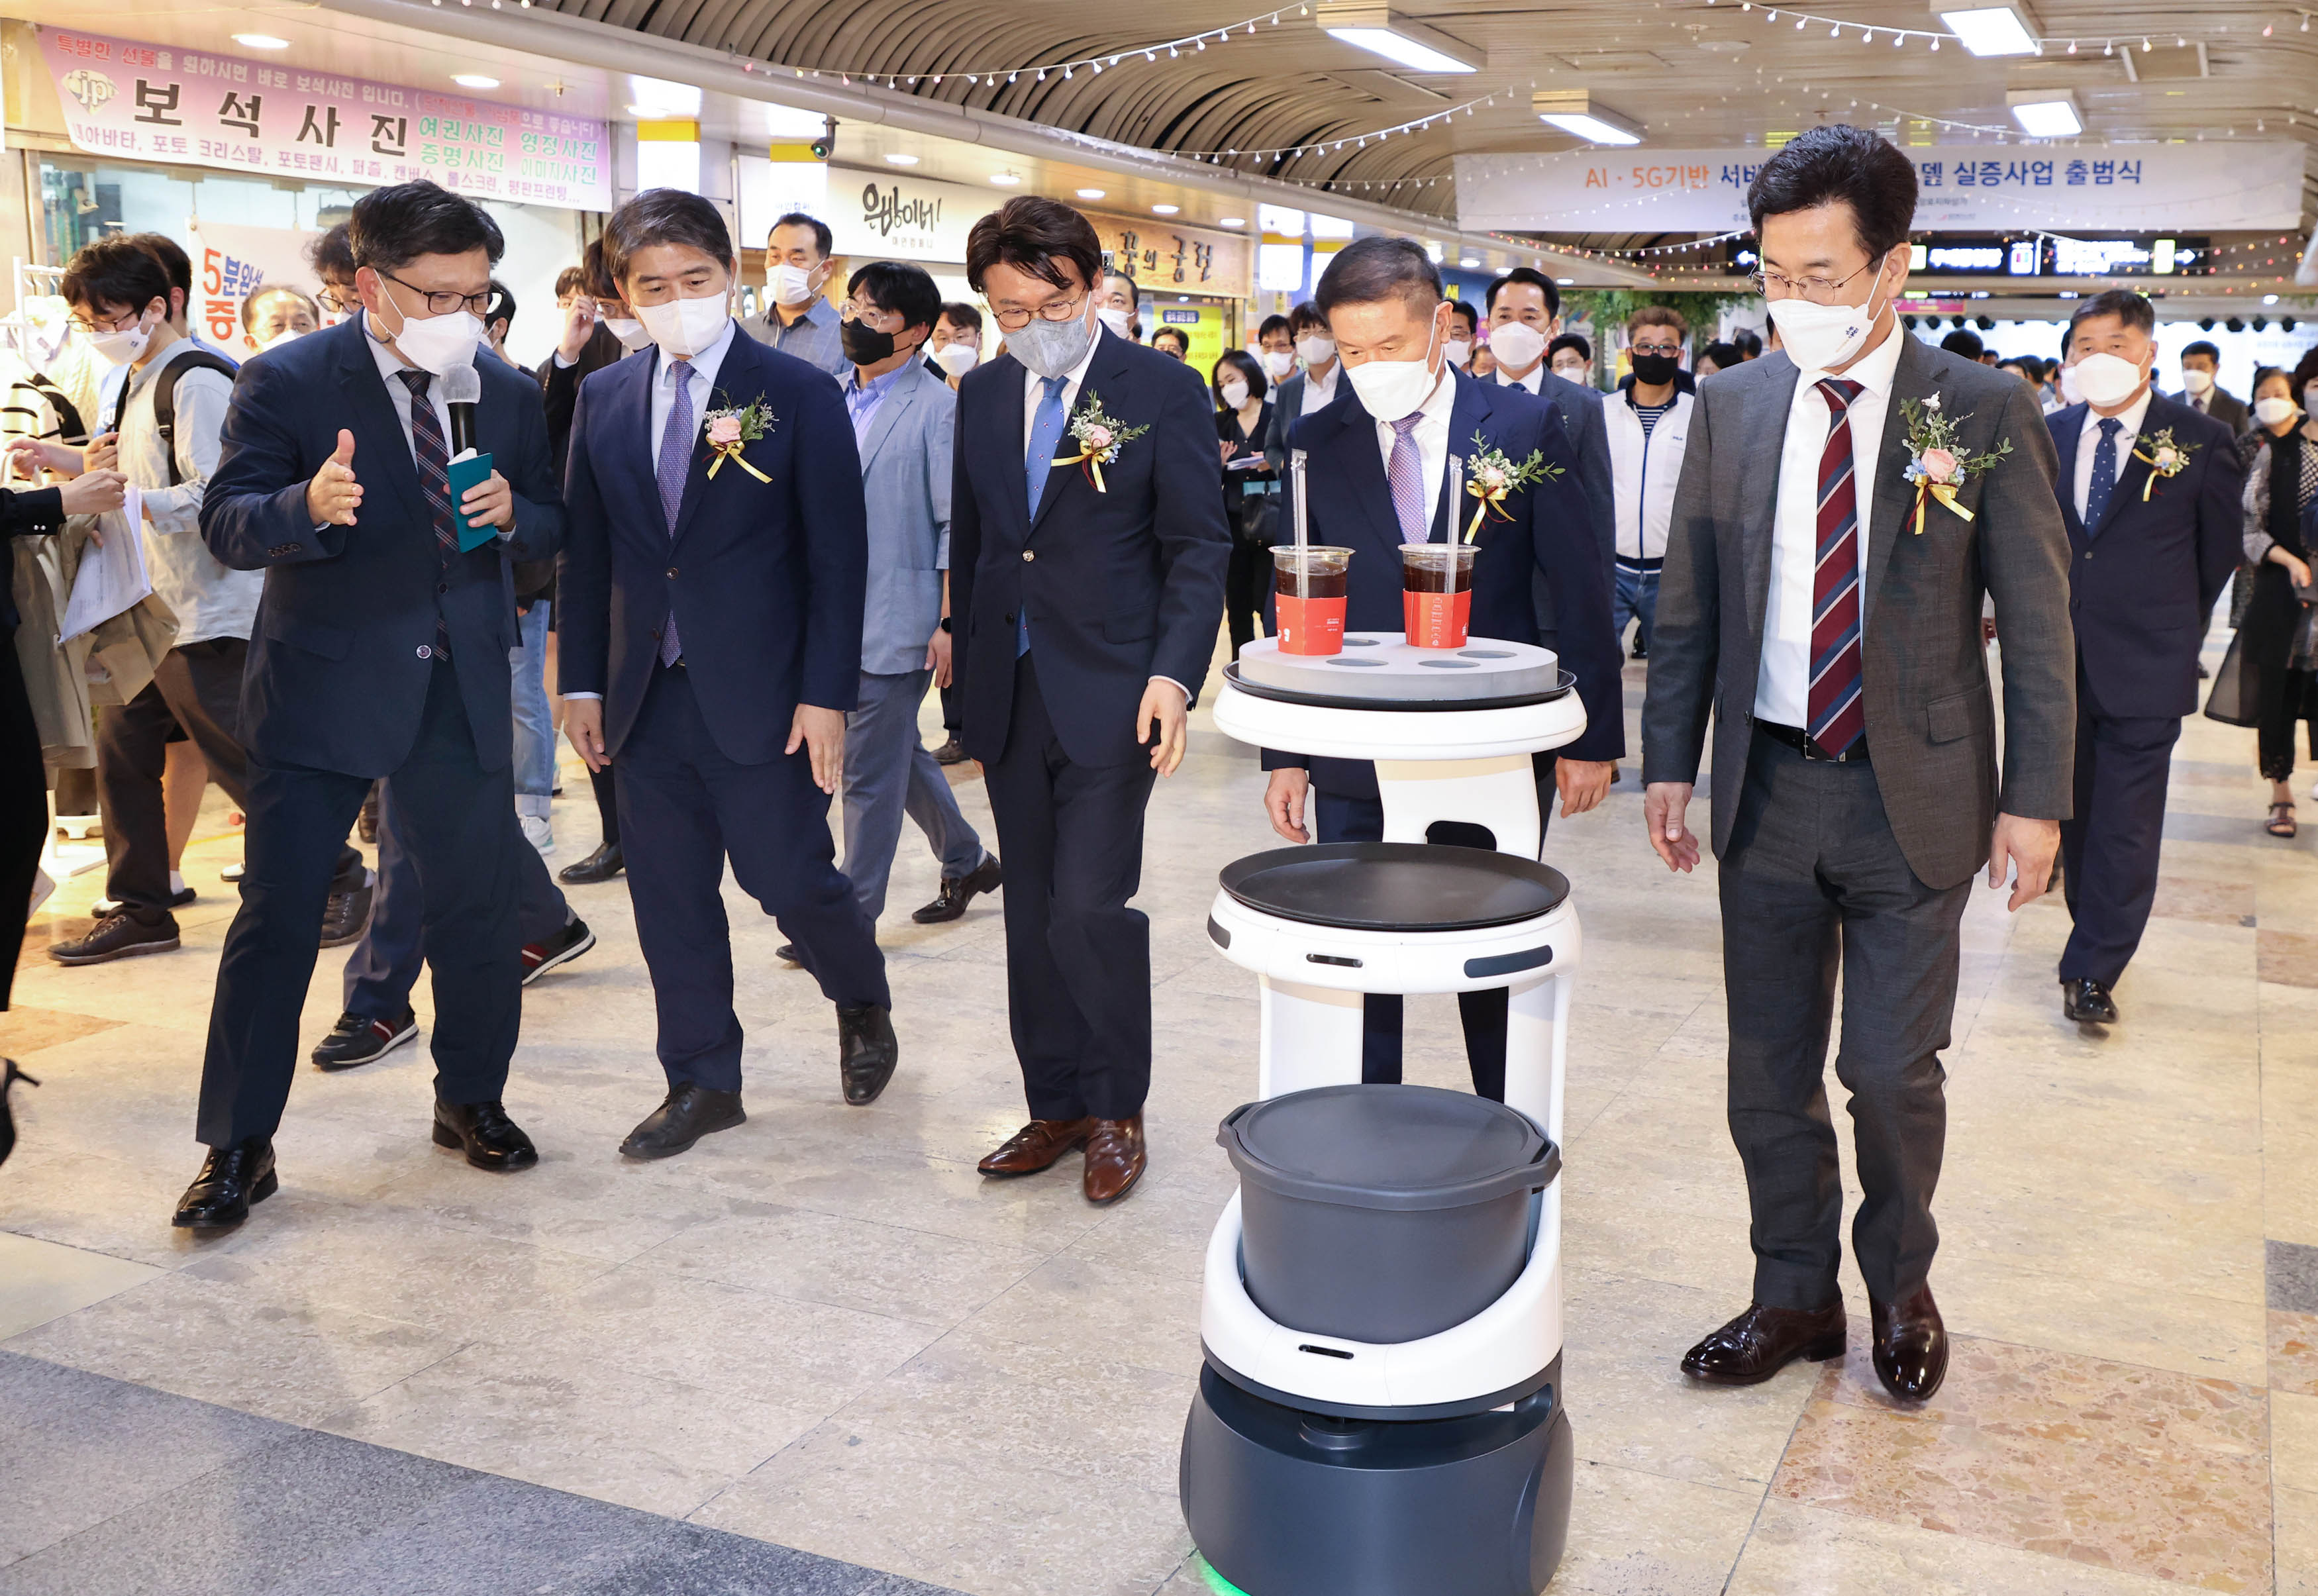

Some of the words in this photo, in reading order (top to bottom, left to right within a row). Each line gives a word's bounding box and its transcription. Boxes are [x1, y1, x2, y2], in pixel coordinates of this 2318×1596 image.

[57, 34, 111, 61] 특별한
[122, 46, 173, 70] 선물을
[258, 68, 288, 89] 바로
[297, 74, 354, 99] 보석사진
[362, 84, 409, 109] 입니다.
[153, 135, 189, 154] 포토
[419, 117, 503, 147] 여권사진
[521, 132, 597, 161] 영정사진
[421, 142, 503, 172] 증명사진
[521, 158, 597, 185] 이미지사진
[1586, 168, 1608, 187] AI
[1632, 166, 1709, 189] 5G기반
[1721, 164, 1762, 189] 서비
[1954, 161, 2054, 186] 실증사업
[2065, 160, 2141, 186] 출범식
